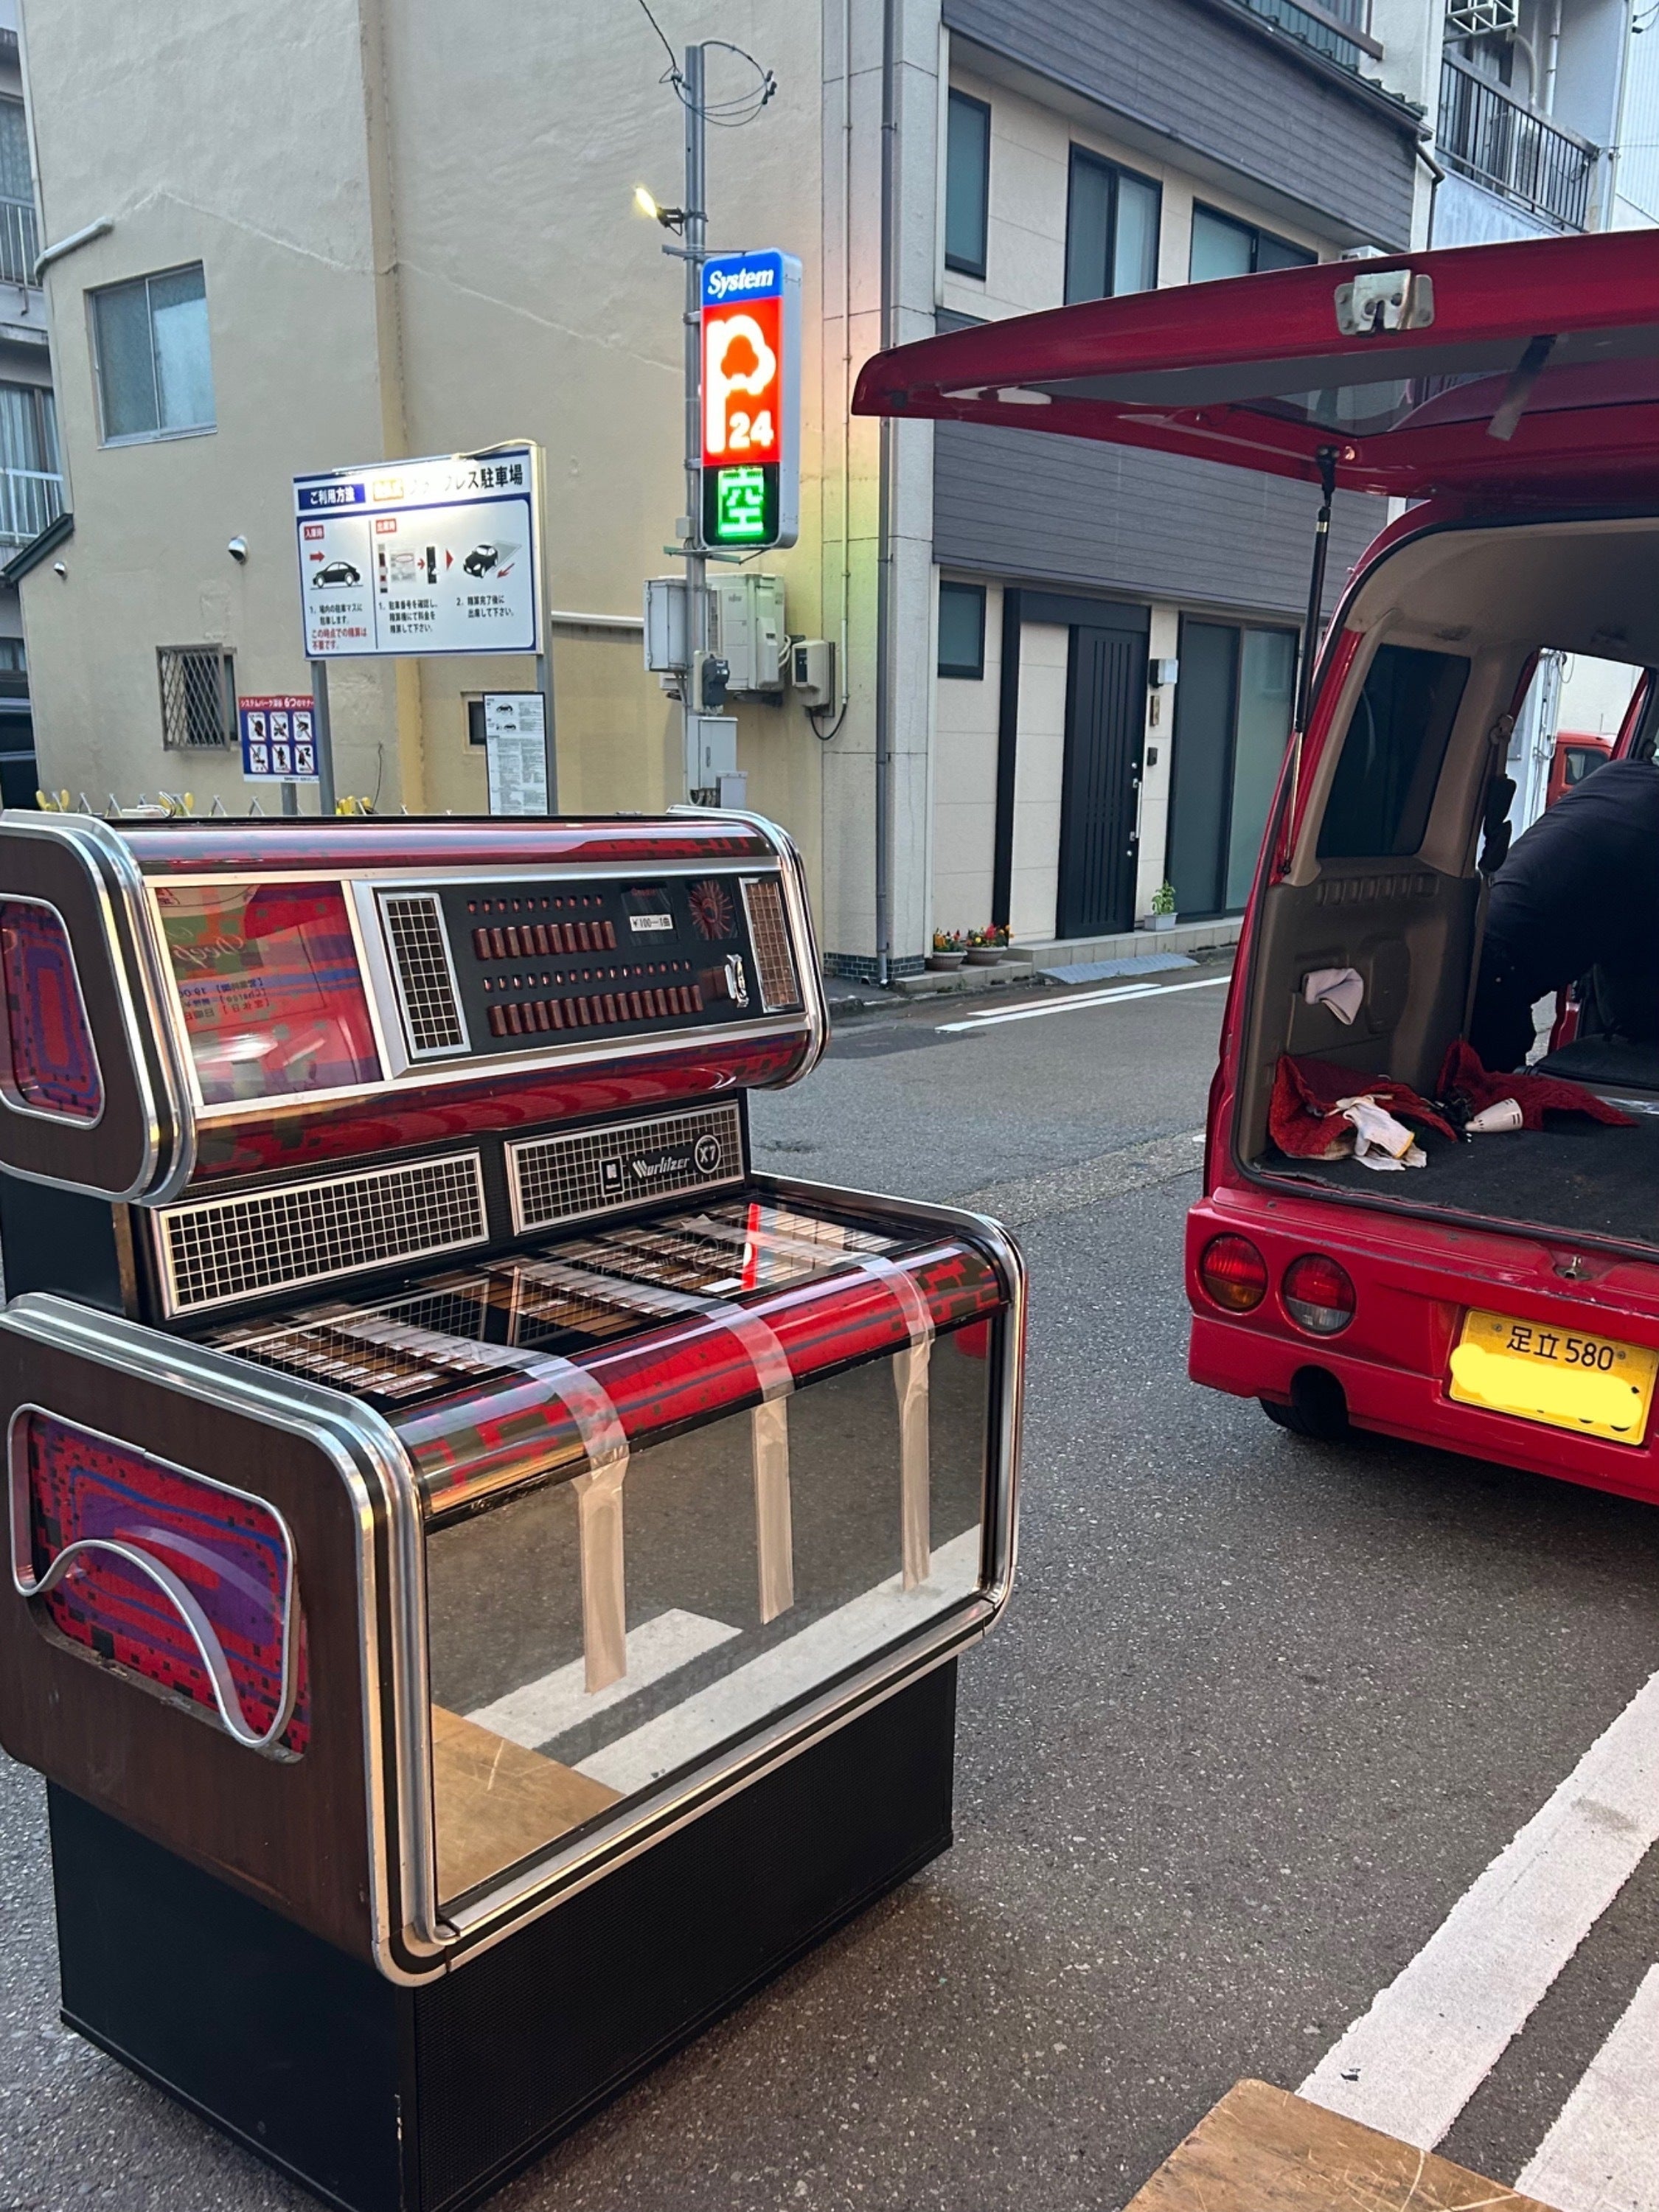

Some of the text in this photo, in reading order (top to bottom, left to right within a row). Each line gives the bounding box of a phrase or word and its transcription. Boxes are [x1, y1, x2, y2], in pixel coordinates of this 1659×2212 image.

[707, 268, 775, 299] System
[729, 410, 774, 449] 24
[720, 467, 765, 536] 空
[632, 1144, 717, 1178] Wurlitzer X7
[1506, 1325, 1615, 1371] 足立 580
